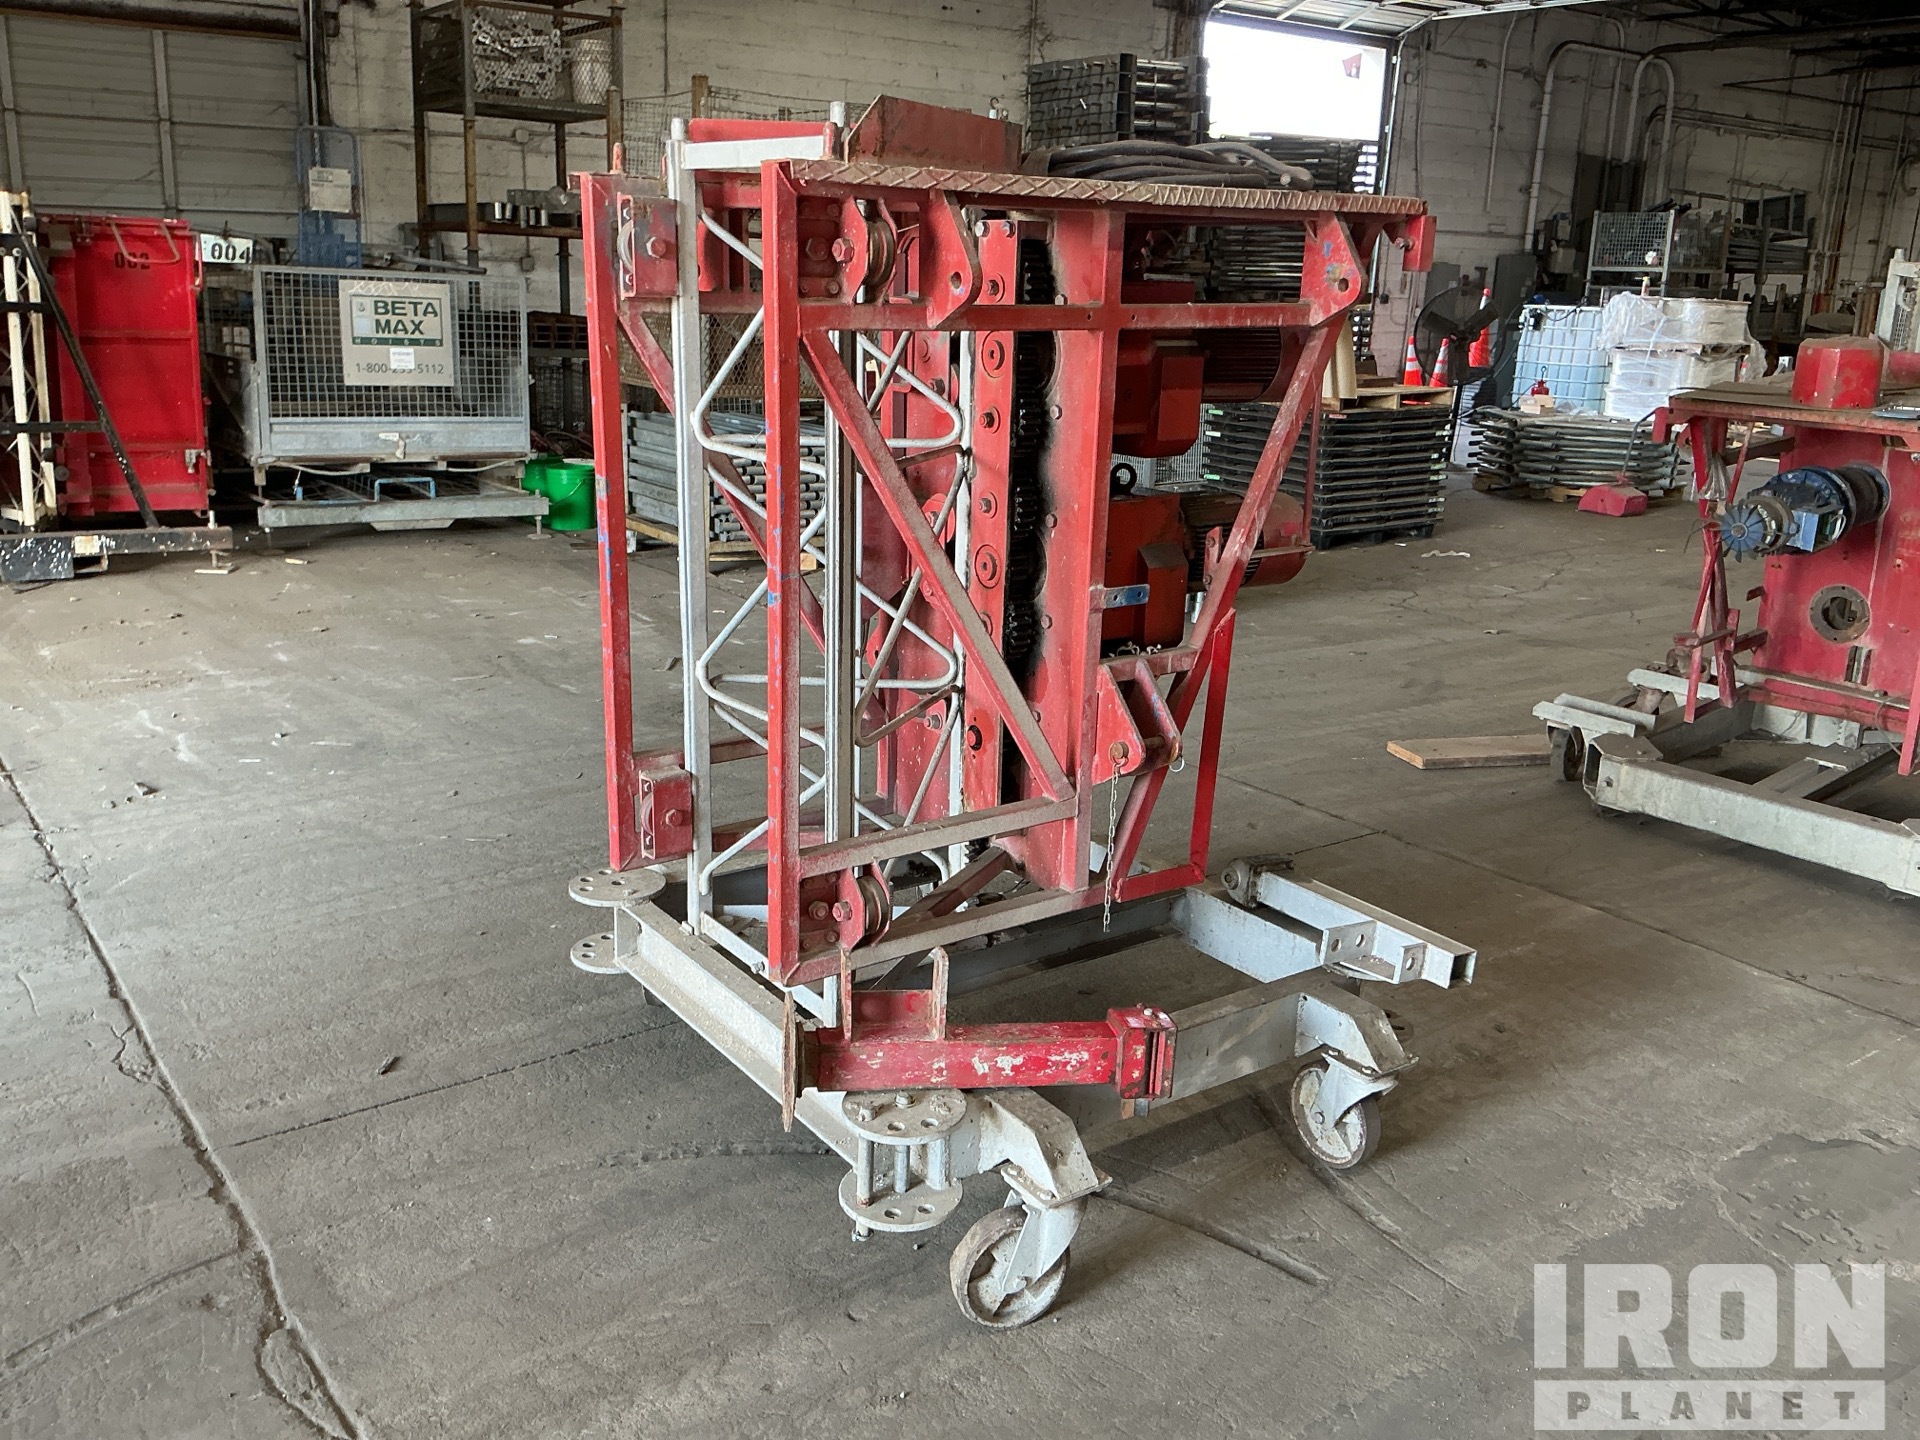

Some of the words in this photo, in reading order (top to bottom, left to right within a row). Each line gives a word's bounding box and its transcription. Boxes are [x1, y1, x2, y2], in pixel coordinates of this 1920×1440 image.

[210, 242, 251, 264] 004
[373, 300, 439, 318] BETA
[375, 318, 425, 335] MAX
